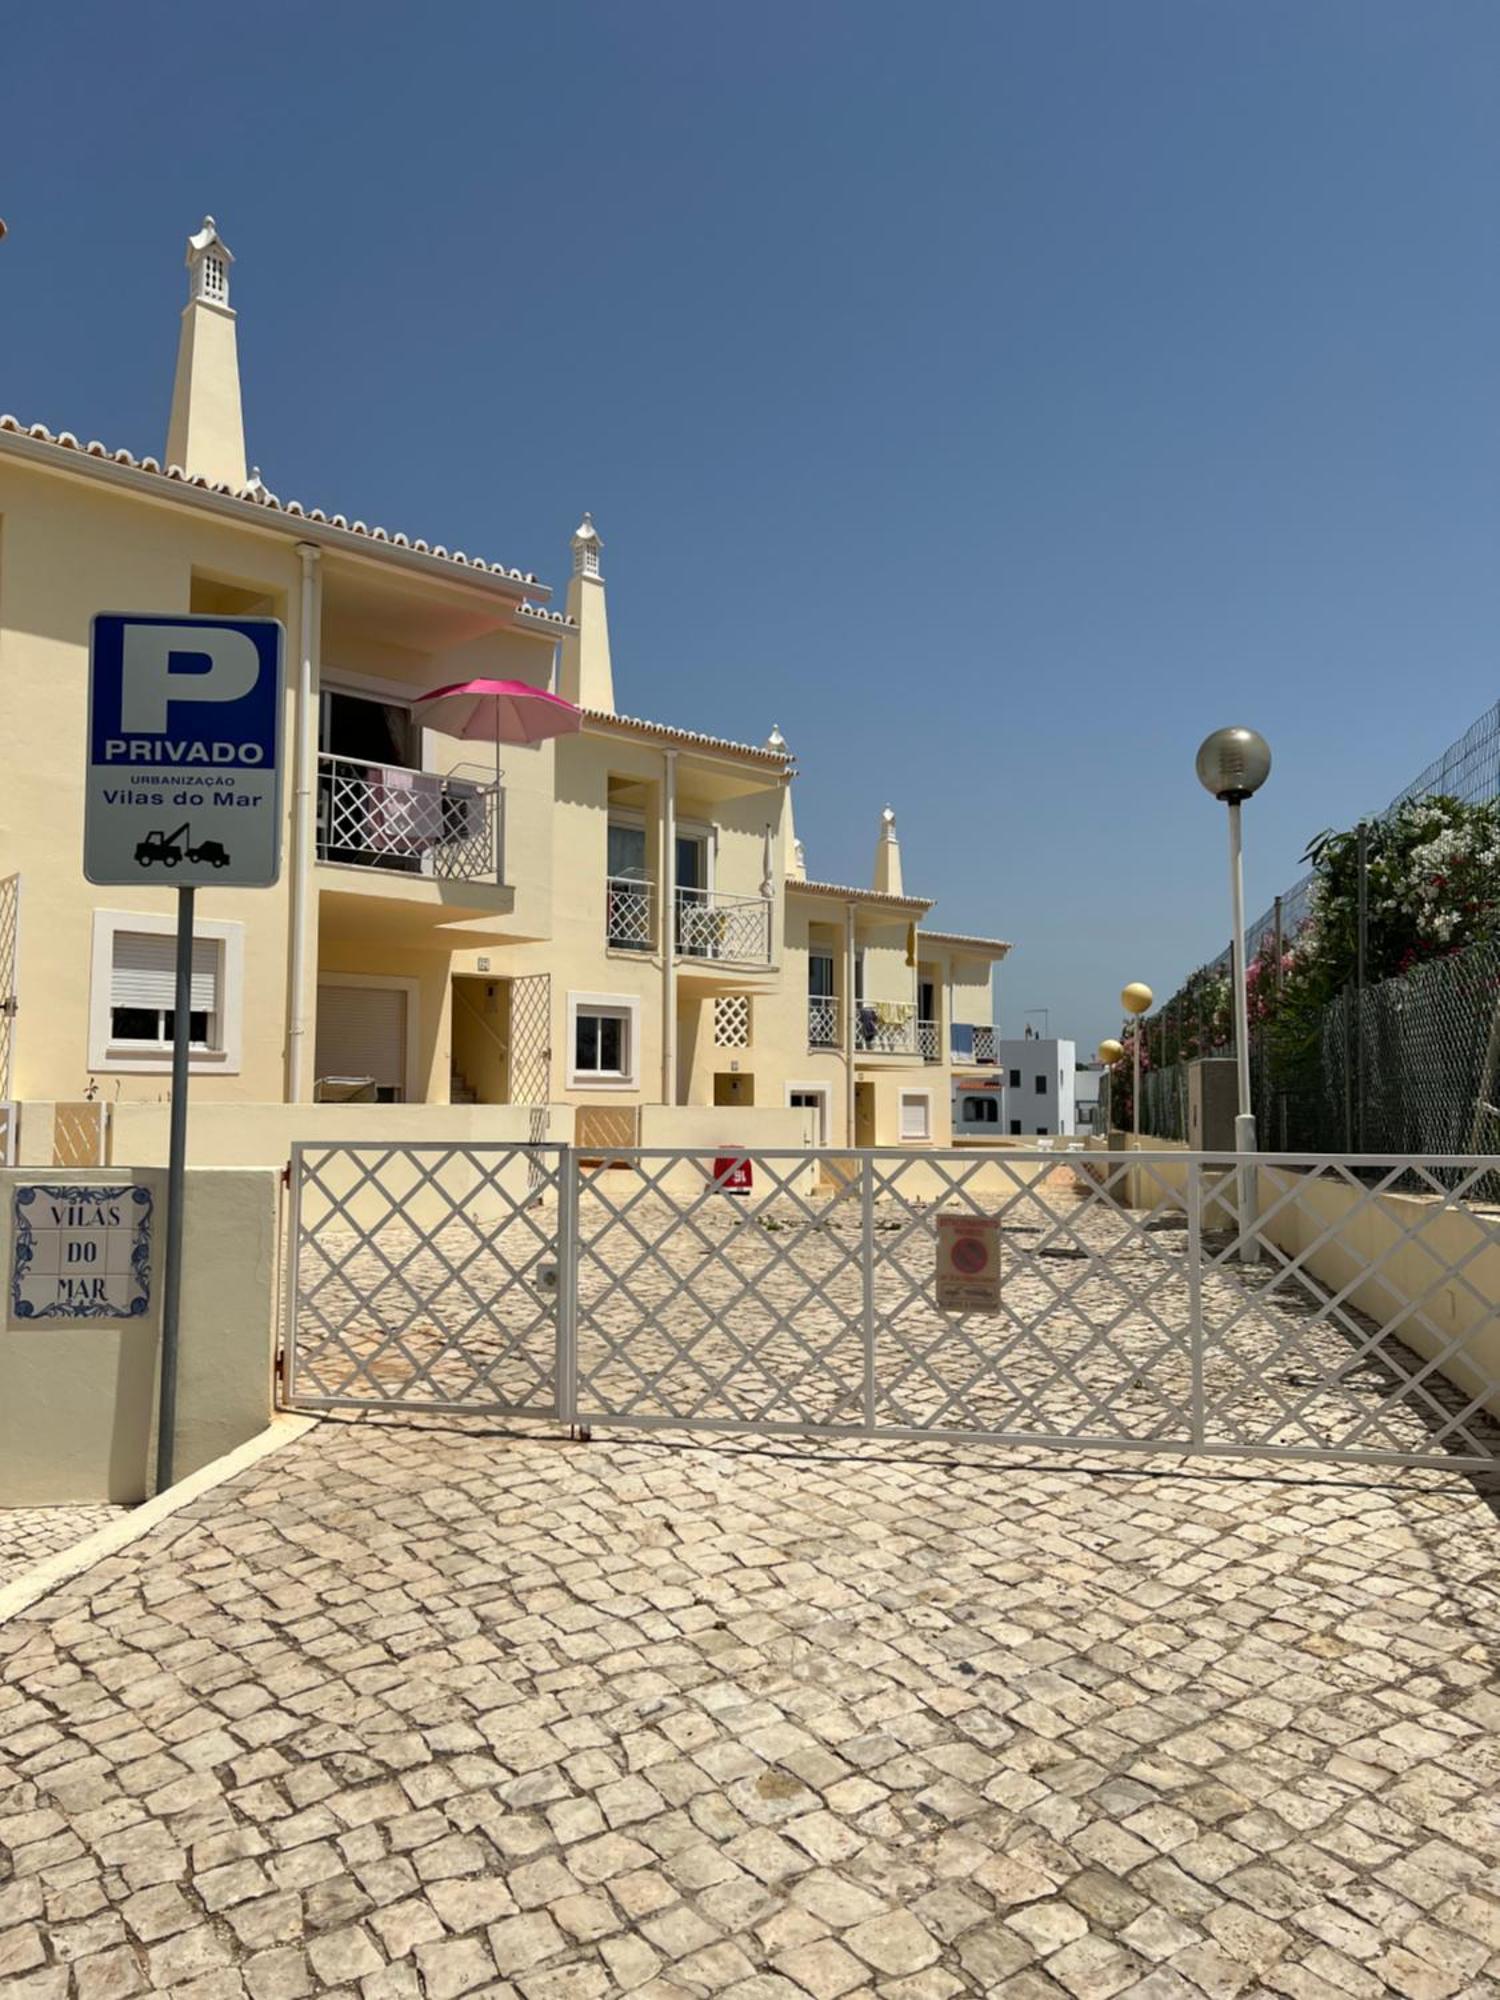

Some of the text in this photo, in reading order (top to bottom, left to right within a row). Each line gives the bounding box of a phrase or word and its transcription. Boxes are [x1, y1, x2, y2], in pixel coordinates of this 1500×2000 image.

[121, 624, 260, 734] P
[105, 739, 264, 765] PRIVADO
[130, 774, 236, 788] URBANIZAÇÃO
[103, 789, 263, 808] Vilas do Mar
[51, 1206, 120, 1227] VILAS
[67, 1241, 97, 1263] DO
[57, 1278, 108, 1301] MAR
